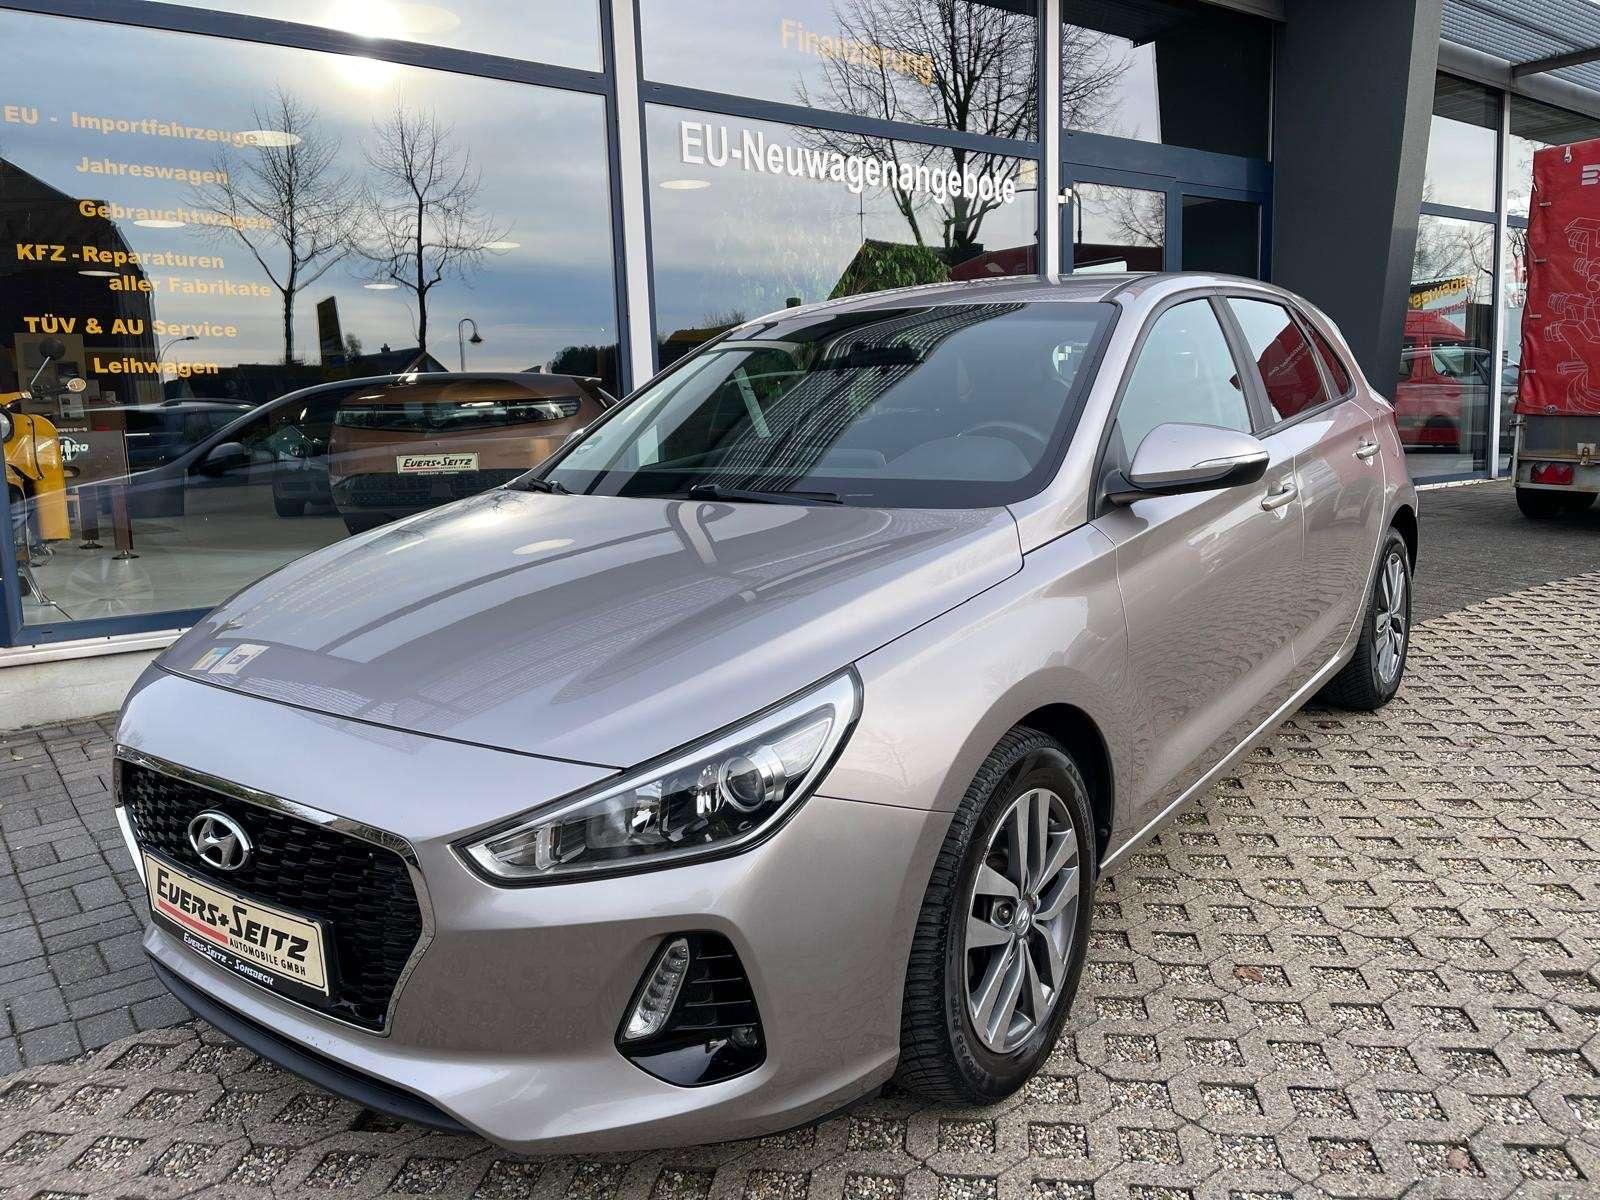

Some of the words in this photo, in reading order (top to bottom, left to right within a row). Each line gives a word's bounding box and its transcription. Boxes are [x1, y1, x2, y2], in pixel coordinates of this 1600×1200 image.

[4, 106, 38, 125] EU
[72, 111, 259, 147] Importfahrzeuge
[76, 157, 229, 185] Jahreswagen
[680, 120, 1015, 203] EU-Neuwagenangebote
[79, 201, 274, 231] Gebrauchtwagen
[16, 244, 67, 262] KFZ
[109, 276, 159, 293] aller
[168, 277, 271, 297] Fabrikate
[24, 313, 75, 334] TÜV
[85, 318, 103, 334] &
[112, 319, 143, 335] AU
[152, 320, 237, 338] Service
[94, 358, 218, 377] Leihwagen
[229, 938, 278, 966] AUTOMOBILE
[281, 959, 306, 976] GMBH
